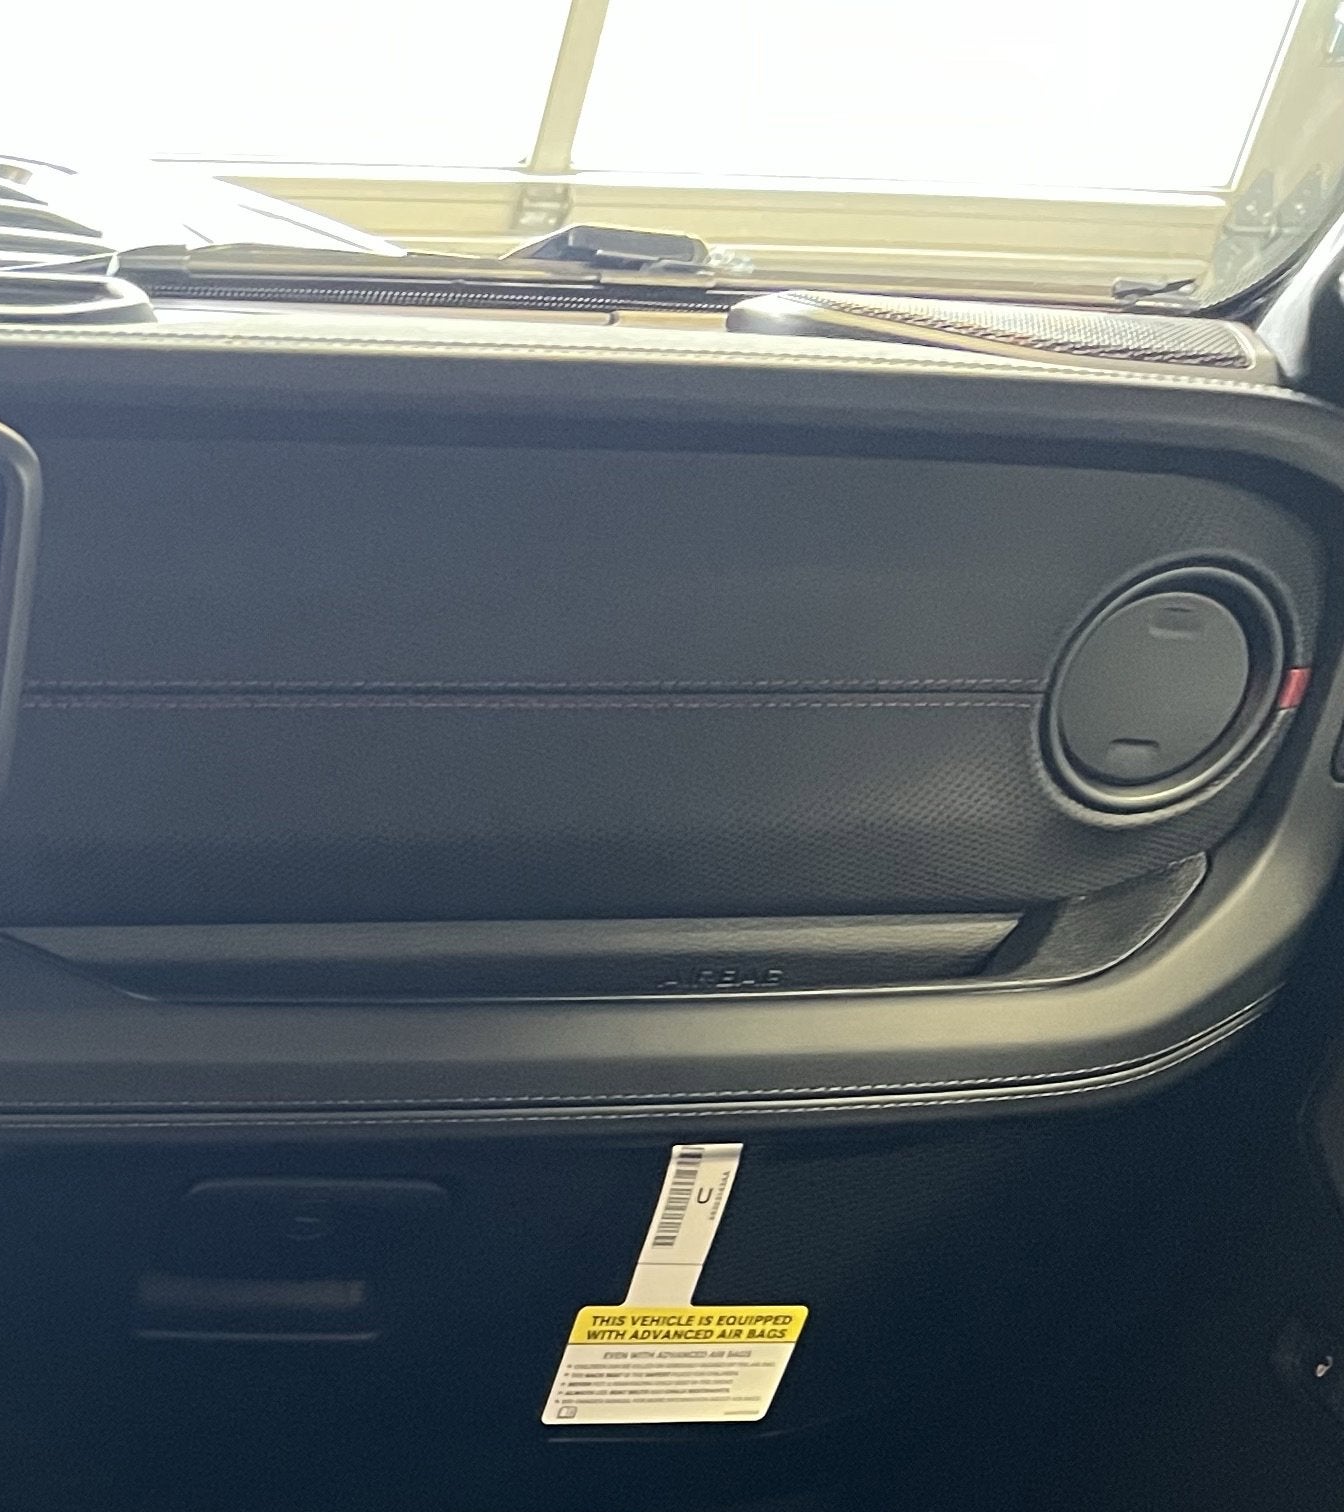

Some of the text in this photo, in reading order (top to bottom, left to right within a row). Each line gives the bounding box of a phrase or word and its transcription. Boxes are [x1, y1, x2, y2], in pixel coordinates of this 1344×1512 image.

[697, 1187, 713, 1204] U
[591, 1314, 793, 1327] THIS VEHICLE IS EQUIPPED
[586, 1328, 788, 1341] WITH ADVANCED AIR BAGS
